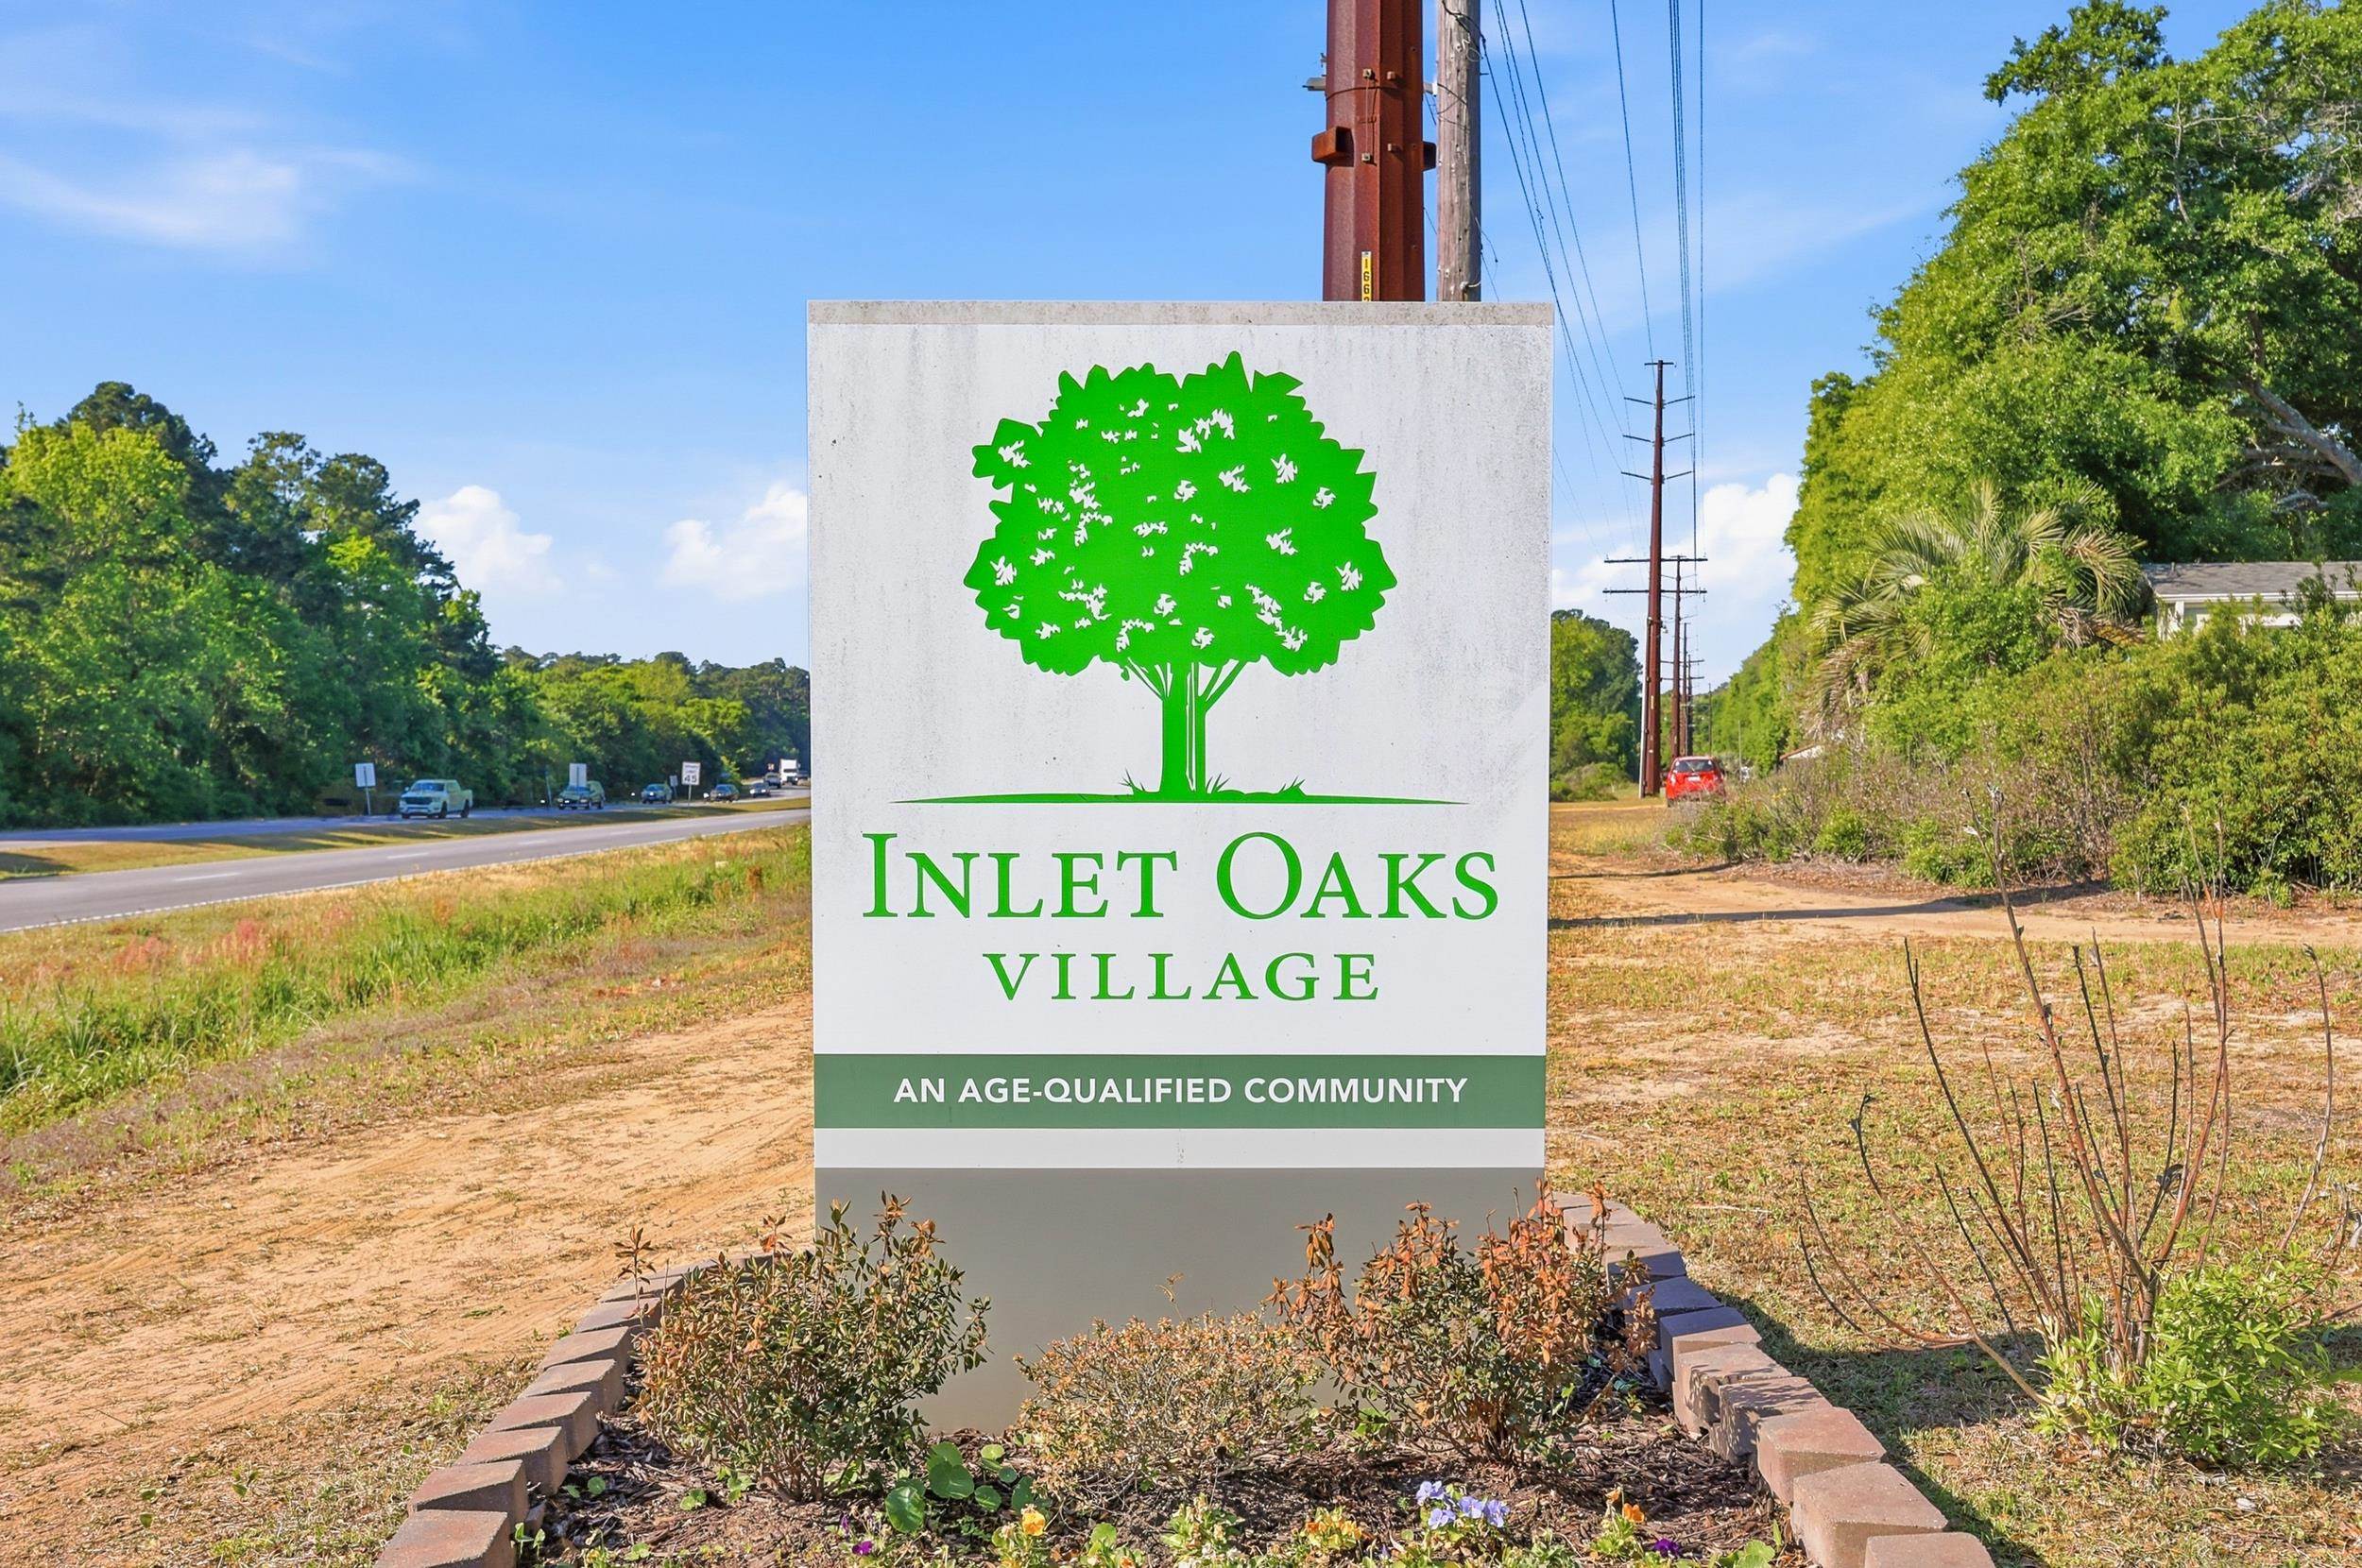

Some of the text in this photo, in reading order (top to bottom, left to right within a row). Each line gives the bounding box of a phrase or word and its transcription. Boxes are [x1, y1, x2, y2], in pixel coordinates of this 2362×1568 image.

[862, 831, 1499, 920] INLET OAKS
[983, 952, 1379, 1001] VILLAGE
[893, 1077, 1468, 1105] AN AGE-QUALIFIED COMMUNITY
